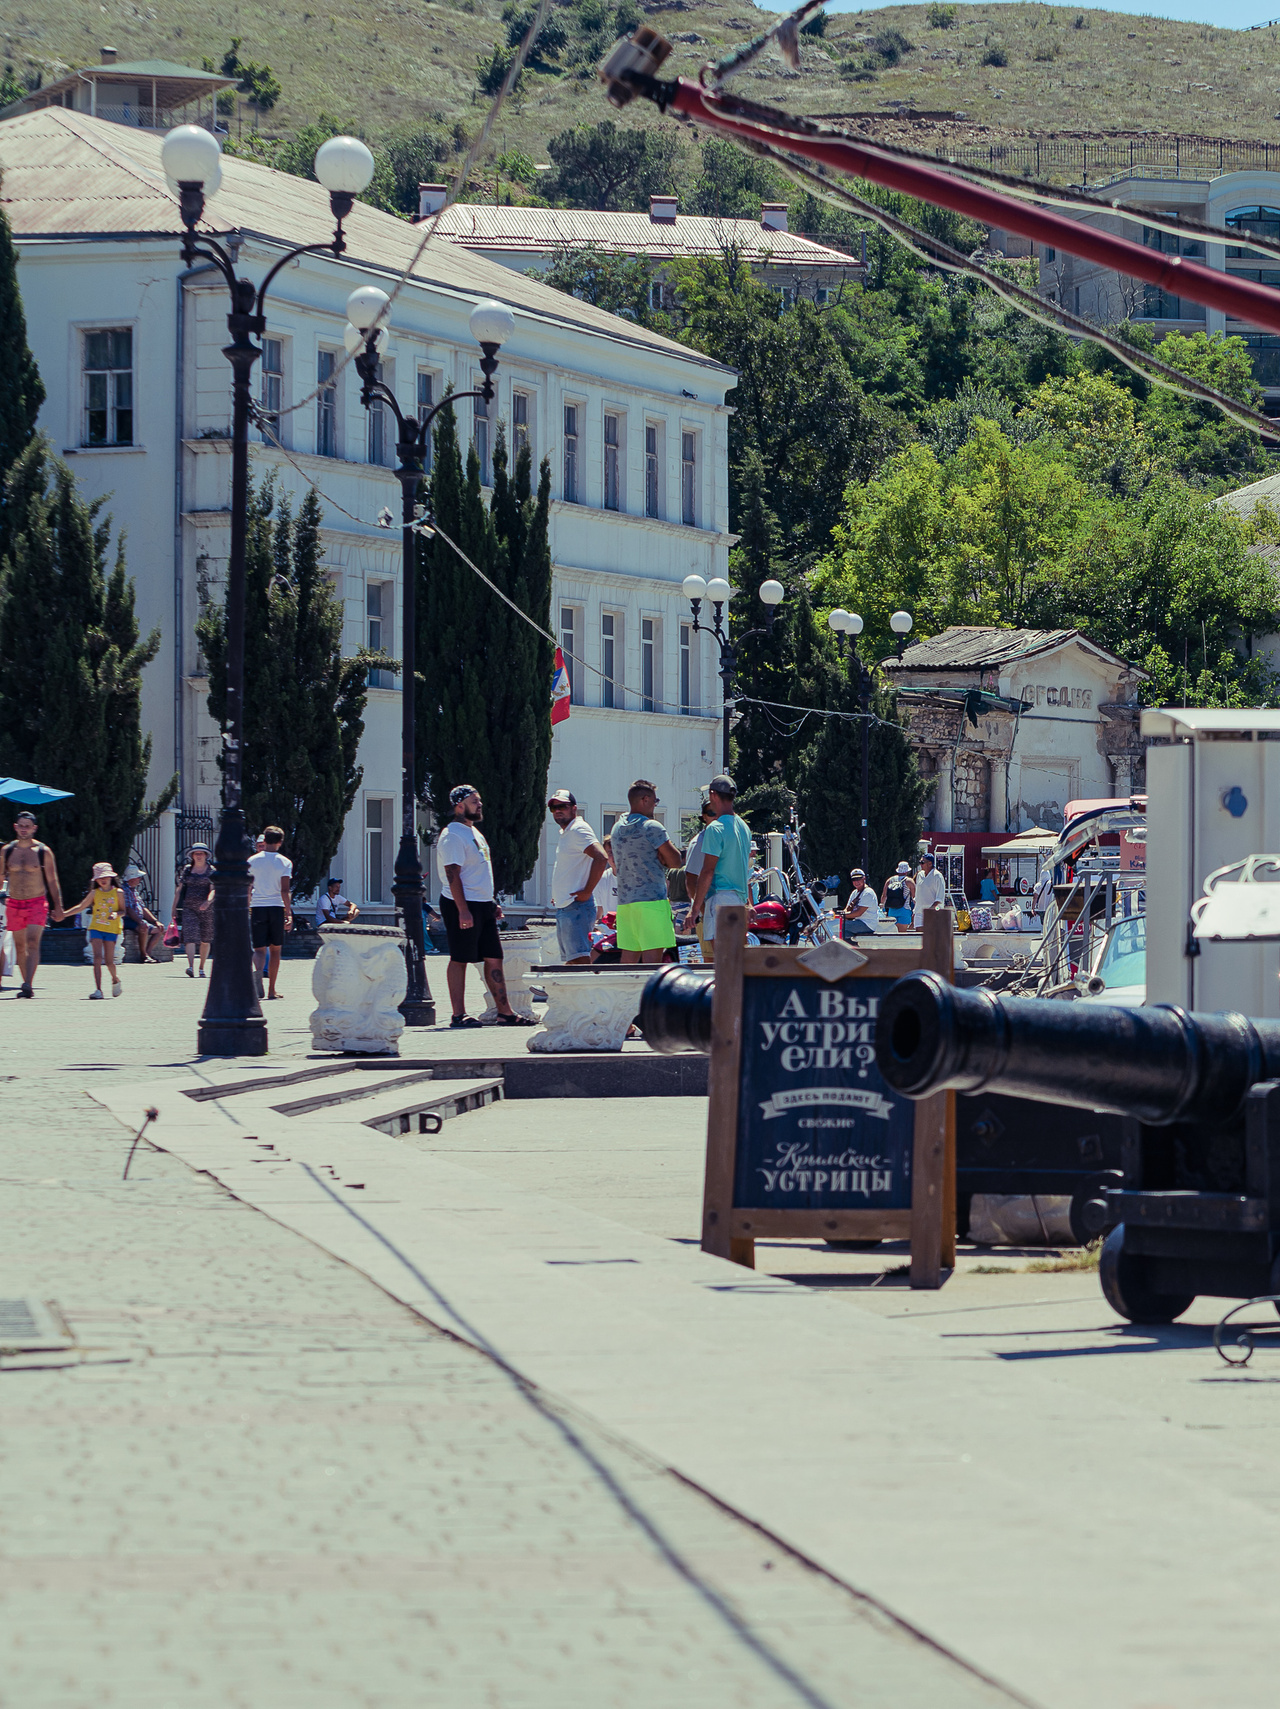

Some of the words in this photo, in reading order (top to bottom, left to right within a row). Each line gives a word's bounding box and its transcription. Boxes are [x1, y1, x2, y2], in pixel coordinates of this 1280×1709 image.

[777, 988, 809, 1018] А
[816, 989, 880, 1018] Вы
[780, 1044, 876, 1078] ели?
[783, 1093, 820, 1104] ЗДЕСЬ
[822, 1092, 871, 1103] ПОДАЮТ
[755, 1169, 893, 1198] УСТРИЦЫ
